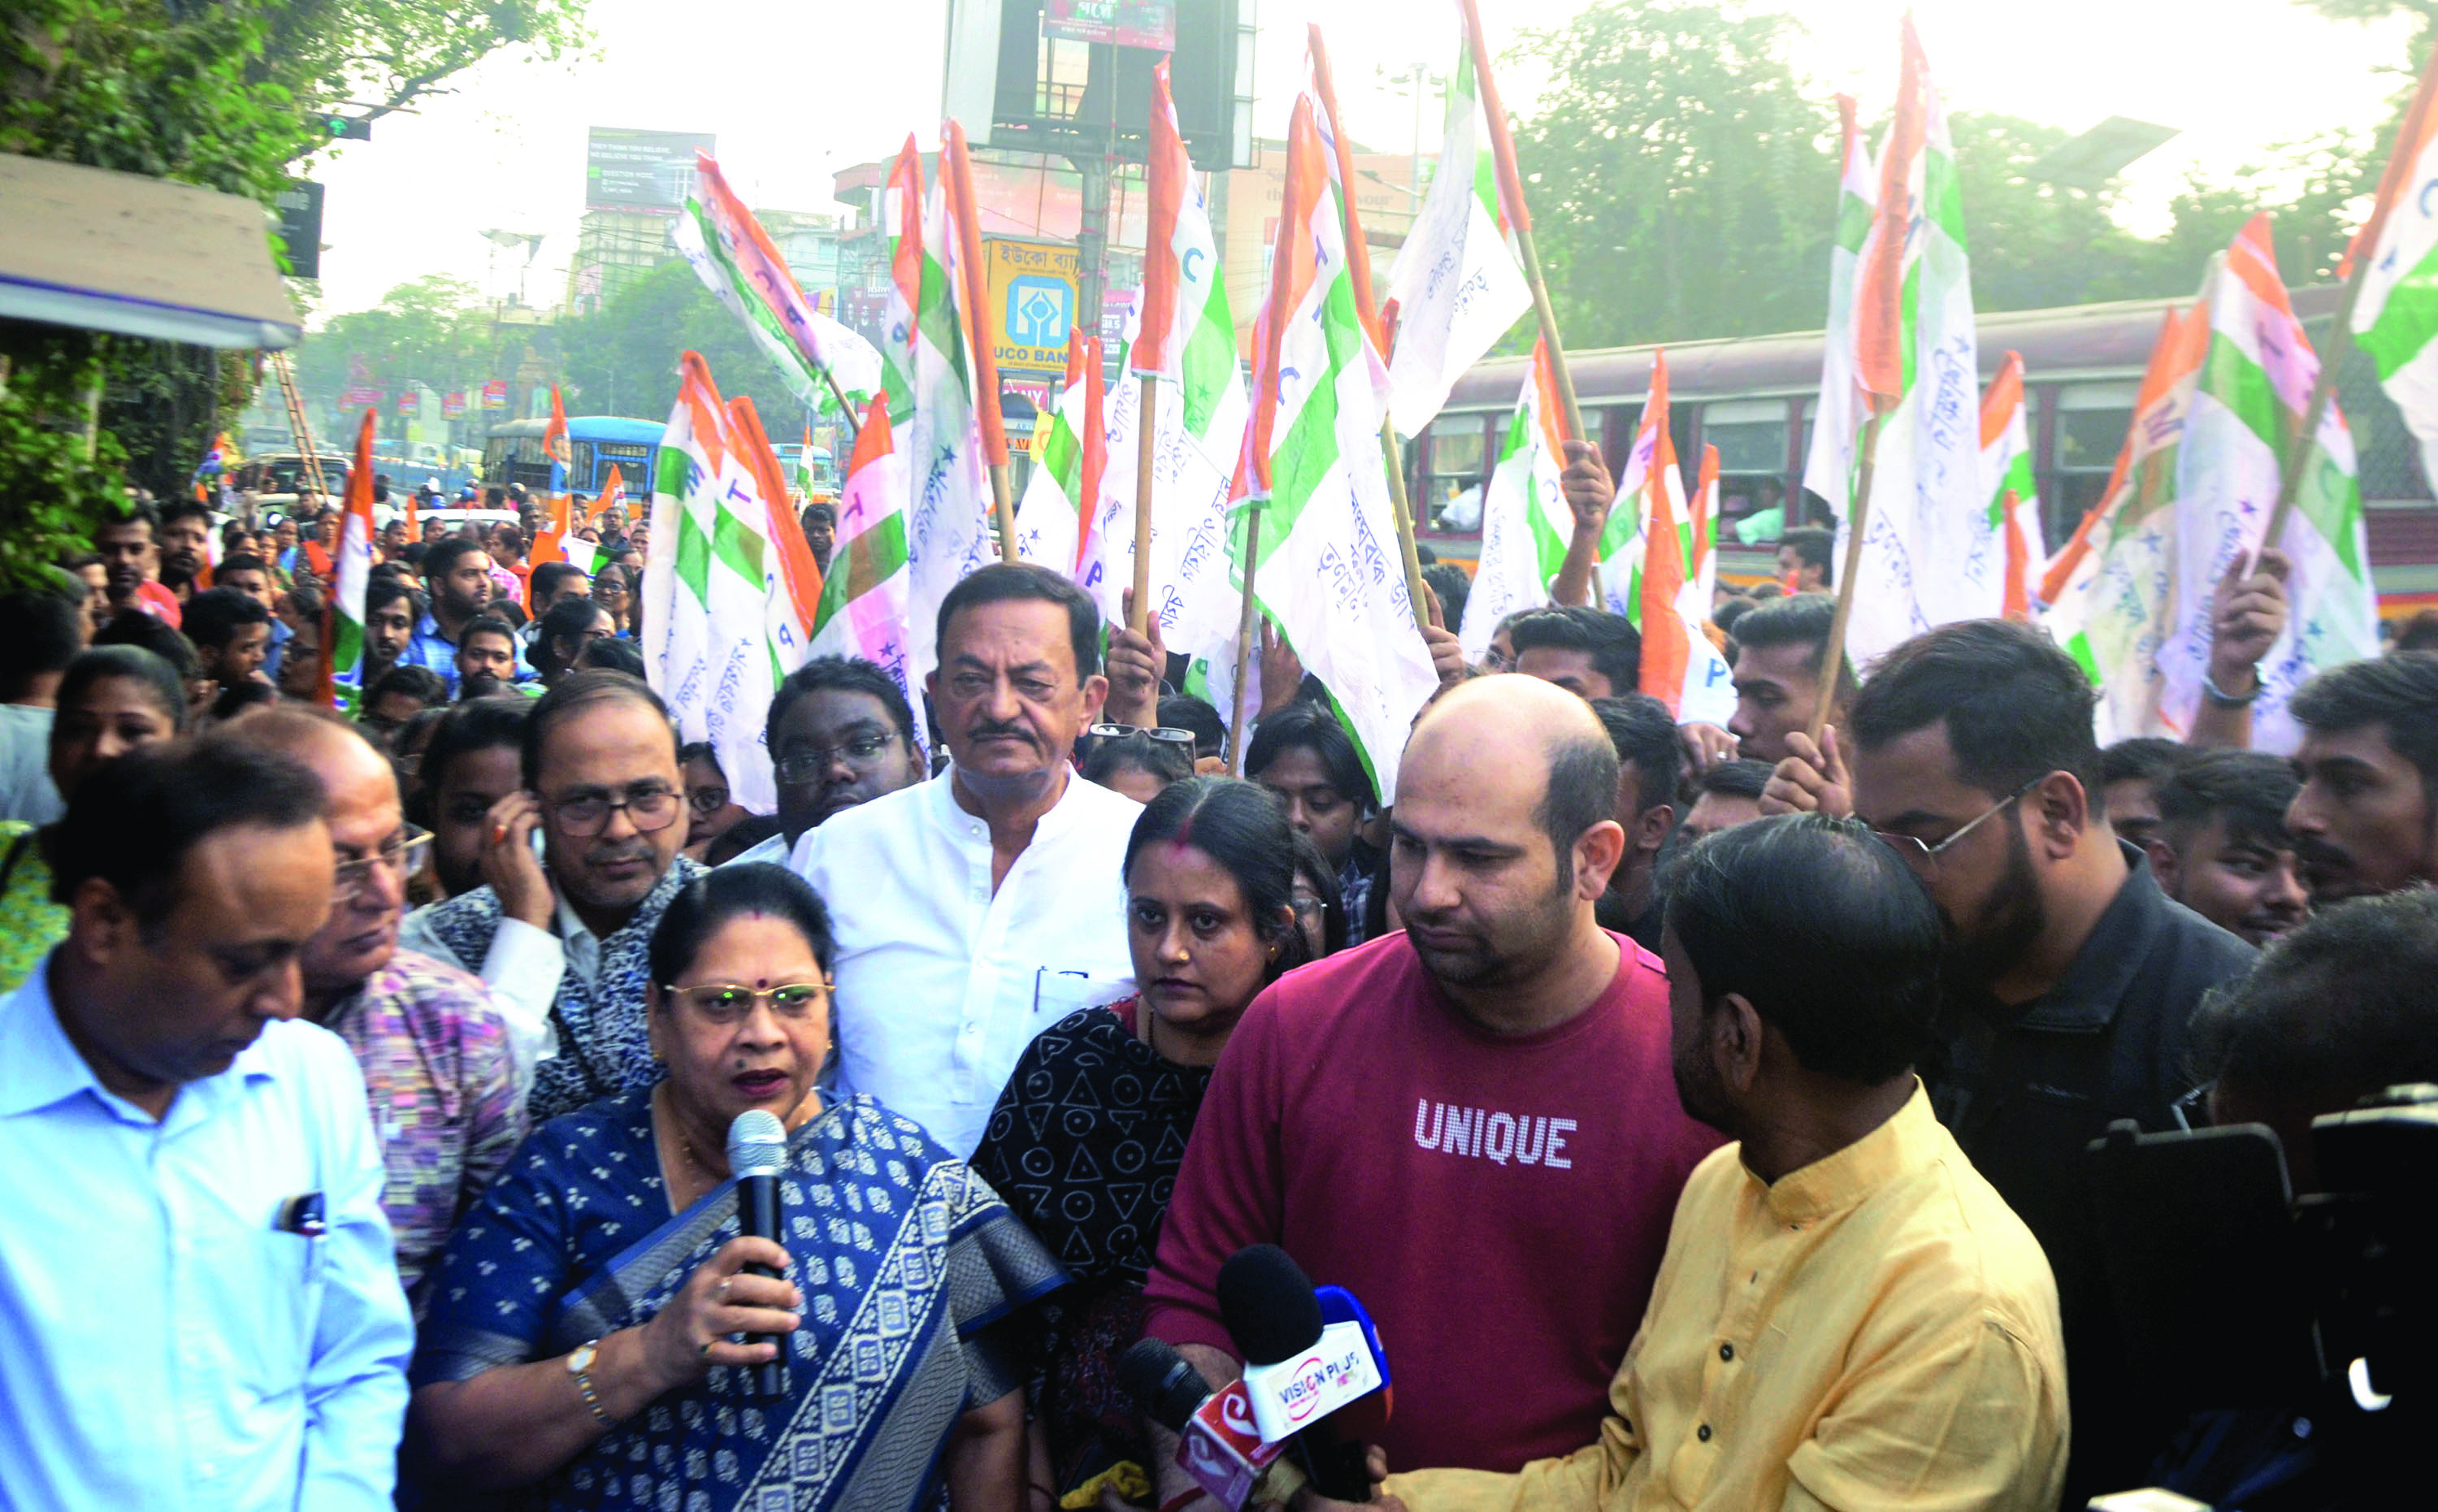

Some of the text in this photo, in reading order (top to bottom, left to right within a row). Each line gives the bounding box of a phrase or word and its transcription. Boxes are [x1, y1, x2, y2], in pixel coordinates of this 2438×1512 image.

[994, 345, 1069, 364] UCO BAN
[1706, 658, 1726, 687] P
[1415, 1098, 1577, 1169] UNIQUE
[1279, 1370, 1325, 1404] VISION
